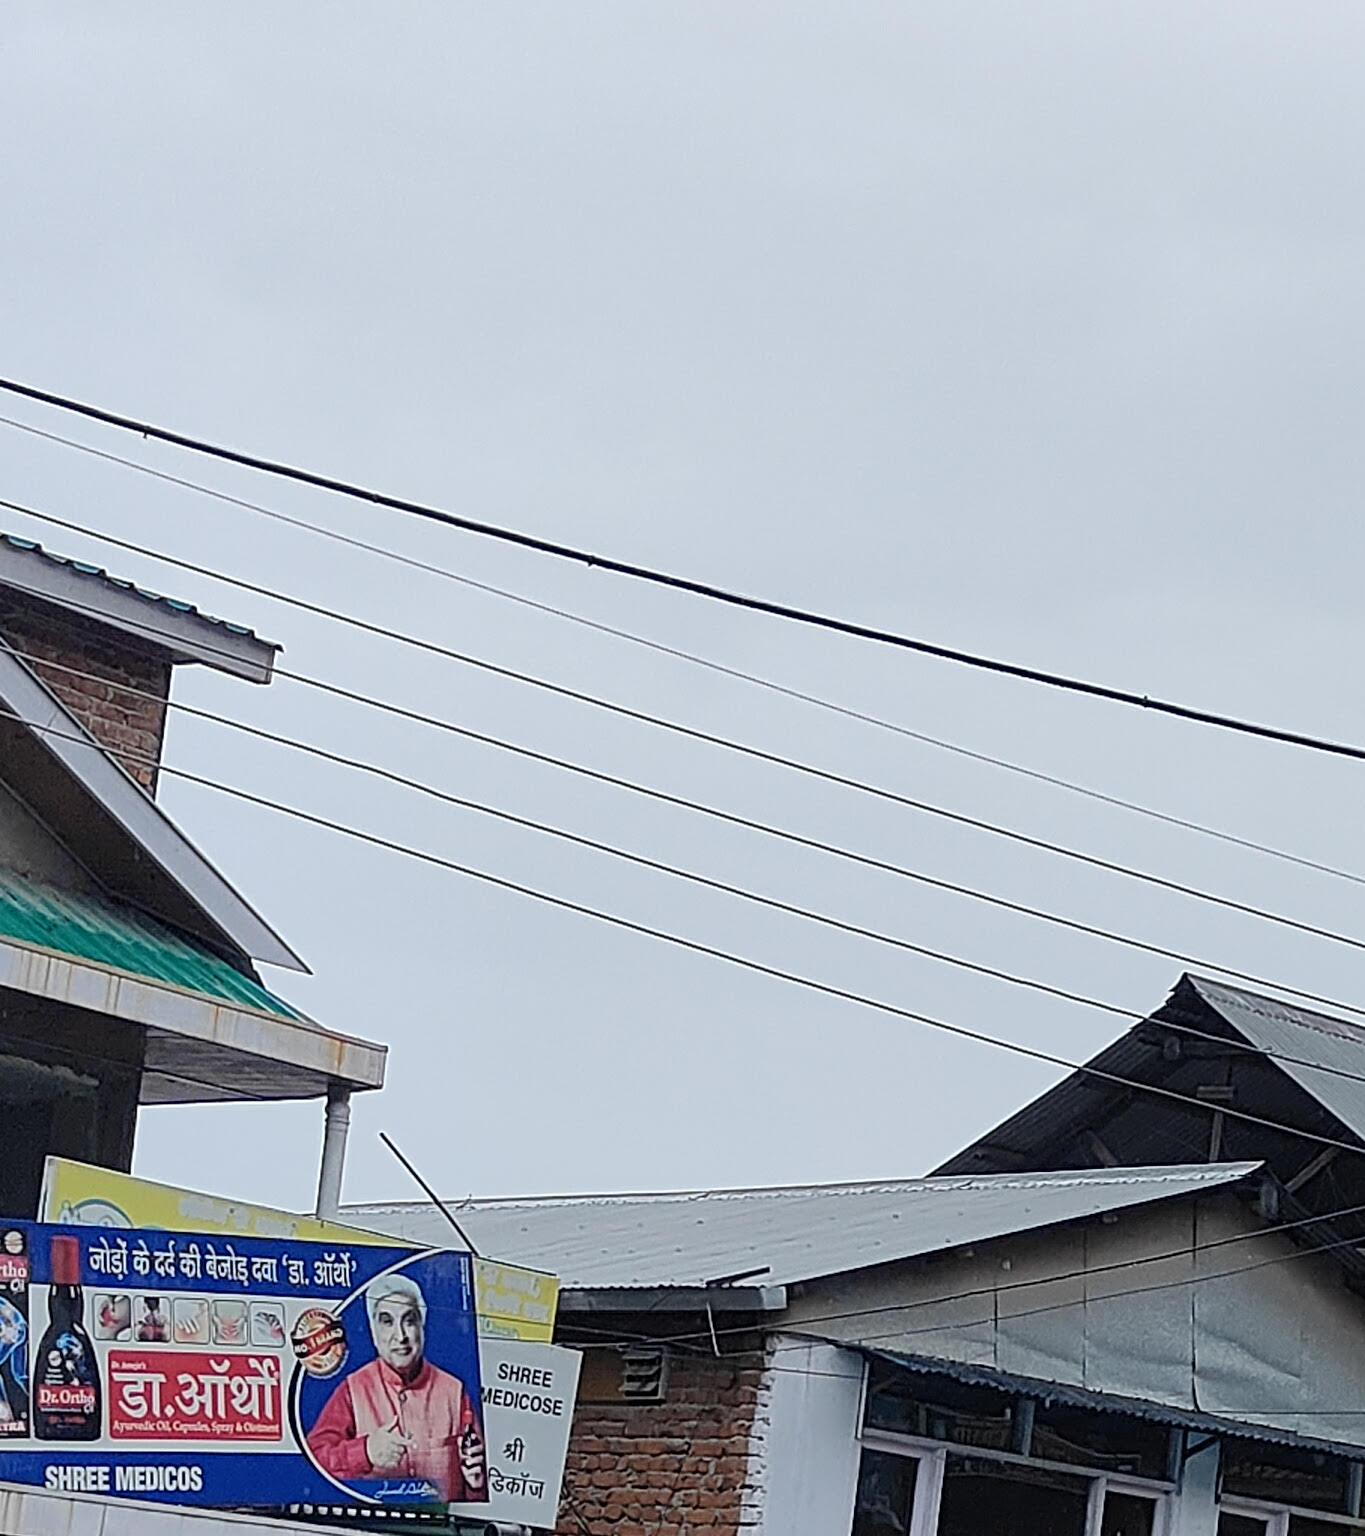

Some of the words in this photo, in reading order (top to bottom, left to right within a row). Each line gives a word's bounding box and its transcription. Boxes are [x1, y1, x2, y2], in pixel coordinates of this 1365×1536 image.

[0, 1260, 28, 1279] rtho
[89, 1237, 128, 1280] जोड़ों
[133, 1239, 149, 1277] के
[153, 1240, 176, 1278] दर्द
[179, 1242, 202, 1280] की
[206, 1243, 249, 1285] बेजोड़
[251, 1254, 278, 1283] दवा
[498, 1363, 552, 1388] SHREE
[39, 1388, 59, 1404] Dr.
[60, 1388, 95, 1405] Ortho
[481, 1387, 563, 1416] MEDICOSE
[112, 1420, 156, 1433] Ayurvedic
[503, 1437, 525, 1463] श्री
[45, 1465, 110, 1490] SHREE
[115, 1466, 202, 1491] MEDICOS
[488, 1470, 544, 1500] डिकॉज
